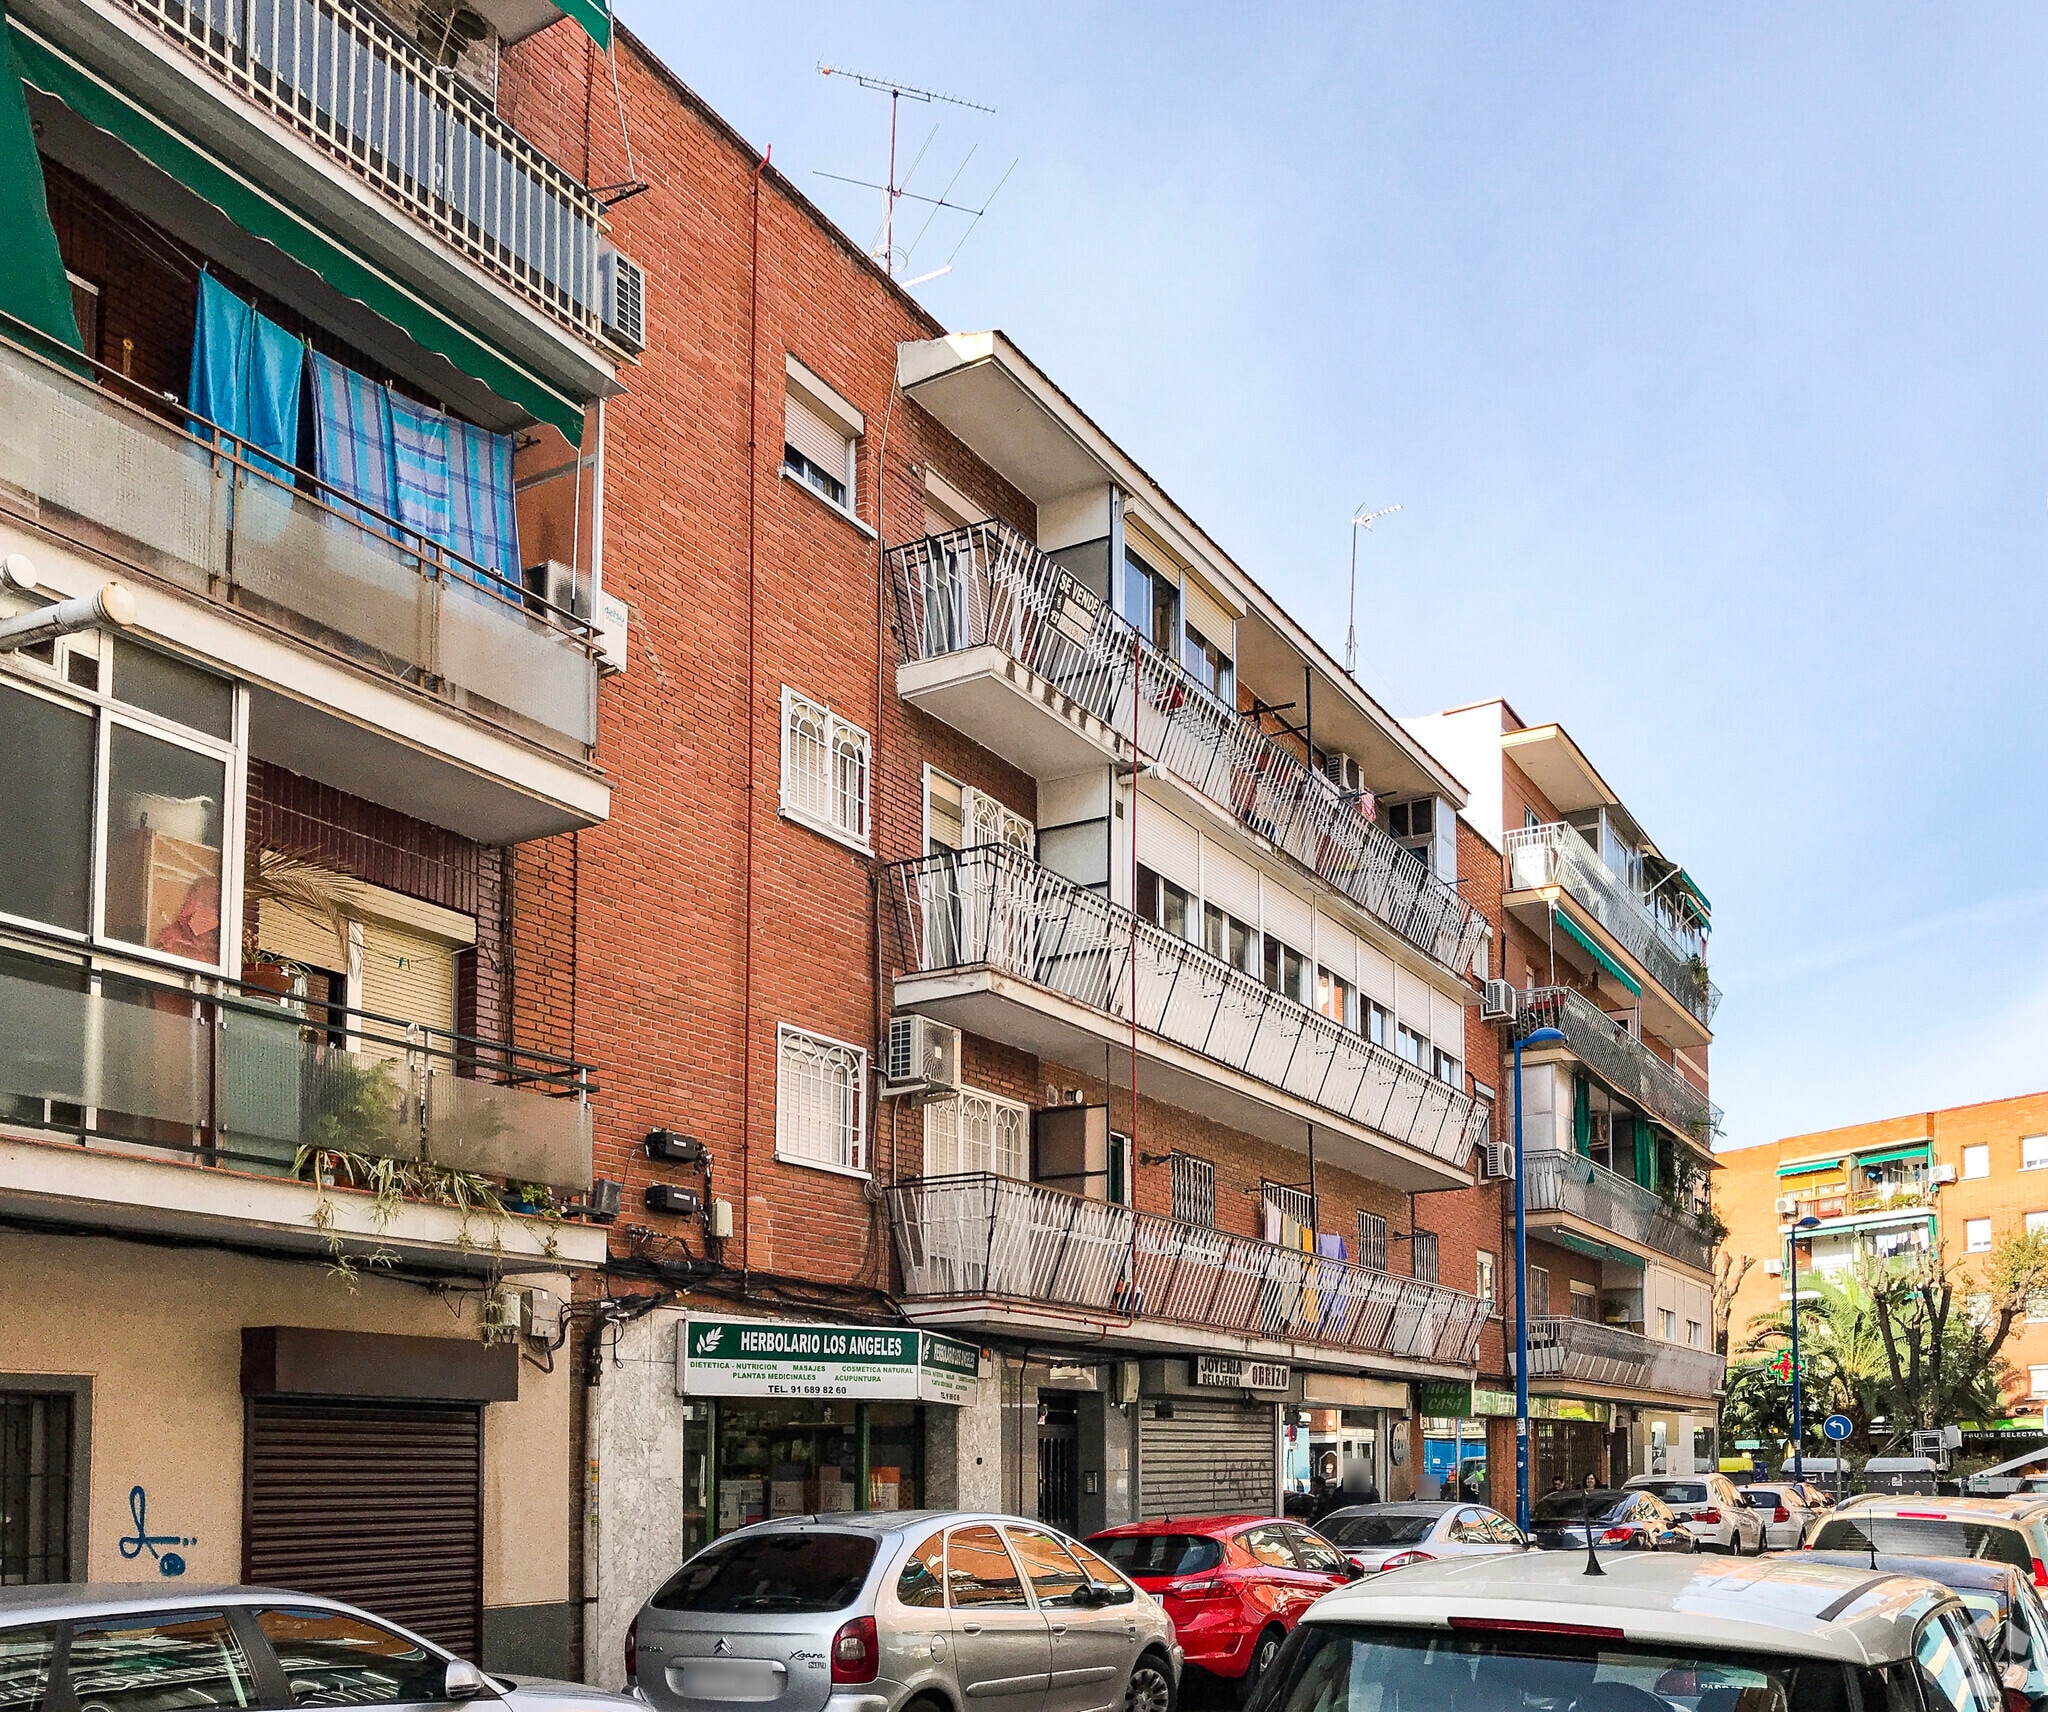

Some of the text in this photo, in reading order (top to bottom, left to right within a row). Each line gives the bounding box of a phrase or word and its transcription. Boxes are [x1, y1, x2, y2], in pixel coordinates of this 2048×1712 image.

[1059, 573, 1100, 616] SE VENDE
[740, 1331, 902, 1357] HERBOLARIO LOS ANGELES
[690, 1361, 730, 1369] DIETETICA
[736, 1363, 778, 1371] NUTRICION
[792, 1364, 826, 1372] MASAJES
[841, 1365, 881, 1373] COSMETICA
[882, 1366, 914, 1374] NATURAL
[1200, 1357, 1243, 1376] JOYERIA
[732, 1372, 882, 1383] PLANTAS MEDICINALES ACUPUNTURA
[1202, 1373, 1241, 1388] RELOJERIA
[1252, 1365, 1288, 1387] OBRIZO
[767, 1385, 847, 1395] TEL. 91 689 82 60
[1428, 1397, 1463, 1410] CASA
[2000, 1431, 2044, 1439] SELECTAS
